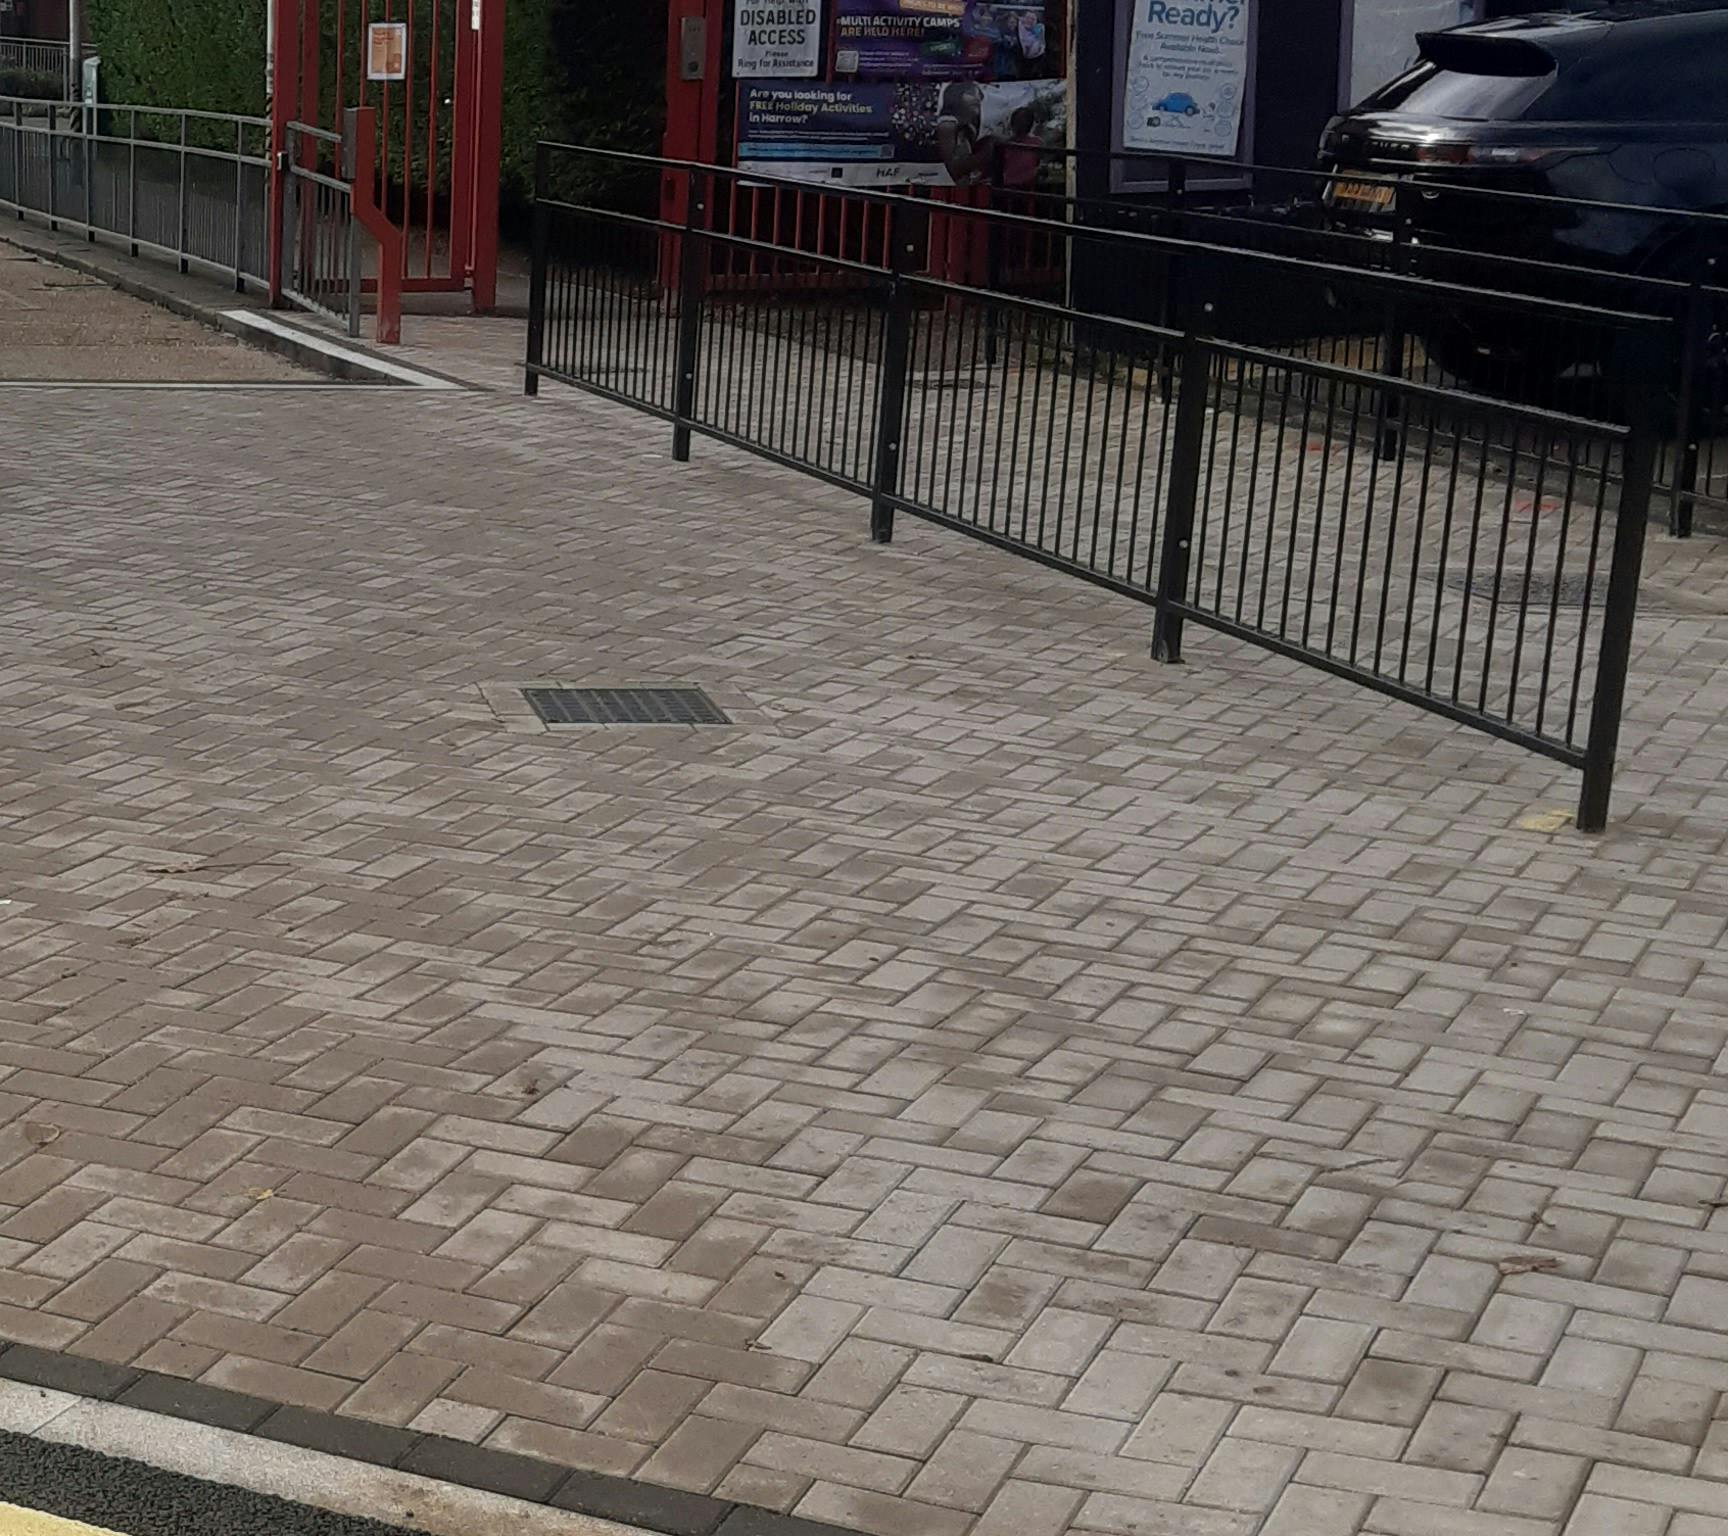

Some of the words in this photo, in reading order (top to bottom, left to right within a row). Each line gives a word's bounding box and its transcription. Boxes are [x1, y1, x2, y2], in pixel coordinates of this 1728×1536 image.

[740, 9, 817, 26] DISABLED
[873, 16, 921, 26] ACTIVITY
[923, 17, 960, 28] CAMPS
[1147, 0, 1240, 33] Ready?
[747, 29, 806, 45] ACCESS
[840, 27, 861, 37] ARE
[864, 27, 889, 37] HELD
[738, 58, 757, 70] Ring
[759, 58, 771, 68] for
[773, 58, 814, 68] Assistance
[750, 89, 769, 98] Are
[771, 91, 792, 100] you
[794, 90, 835, 103] looking
[837, 91, 852, 101] for
[750, 101, 772, 110] FREE
[776, 102, 818, 114] Holiday
[821, 102, 872, 114] Activities
[761, 113, 808, 124] Harrow?
